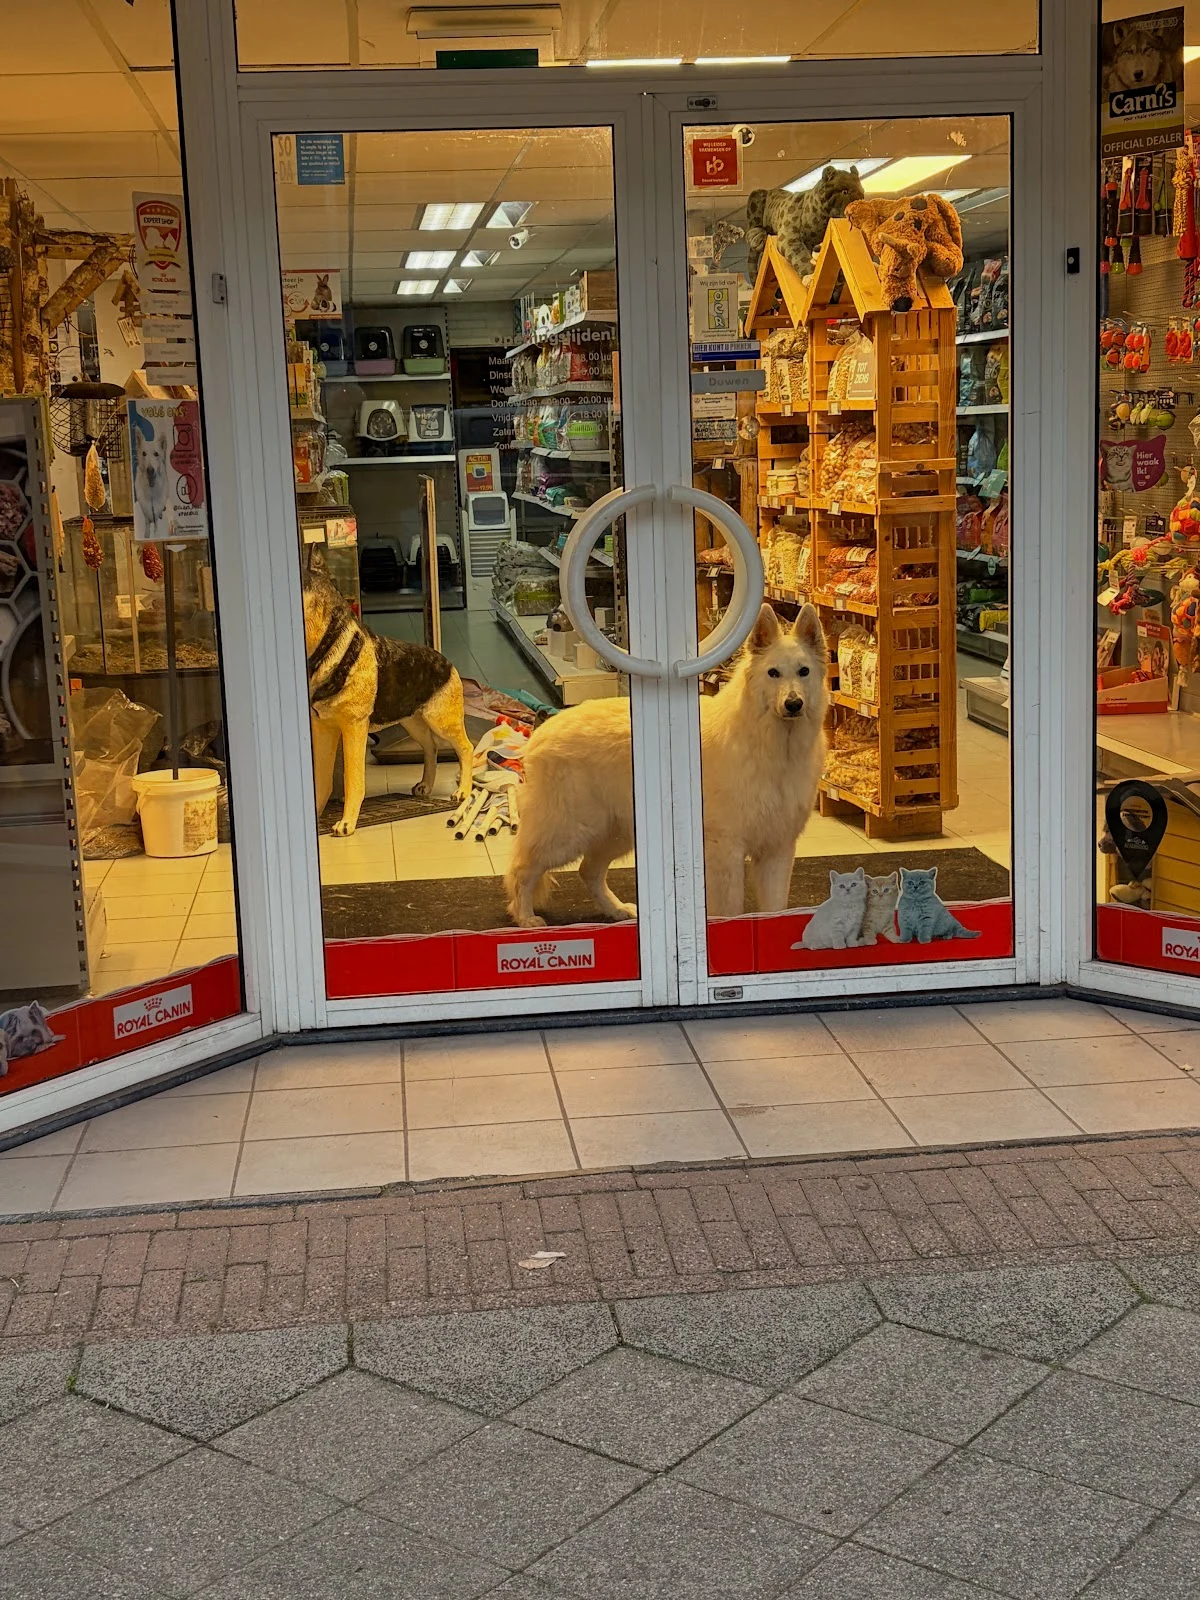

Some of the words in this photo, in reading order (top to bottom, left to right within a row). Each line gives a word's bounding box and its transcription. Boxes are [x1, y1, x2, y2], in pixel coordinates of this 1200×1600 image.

[1111, 84, 1174, 115] Carnis
[1103, 138, 1144, 153] OFFICIAL
[1146, 132, 1182, 147] DEALER
[143, 216, 160, 224] EXPERT
[694, 344, 708, 352] HIER
[708, 343, 724, 351] KUNT
[724, 343, 729, 351] U
[708, 376, 749, 386] Duwen
[1136, 451, 1153, 460] Hier
[1136, 457, 1159, 467] waak
[1165, 942, 1199, 960] ROYA
[500, 956, 545, 971] ROYAL
[547, 953, 592, 968] CANIN
[116, 1013, 153, 1036] ROYAL
[154, 1000, 191, 1023] CANIN
